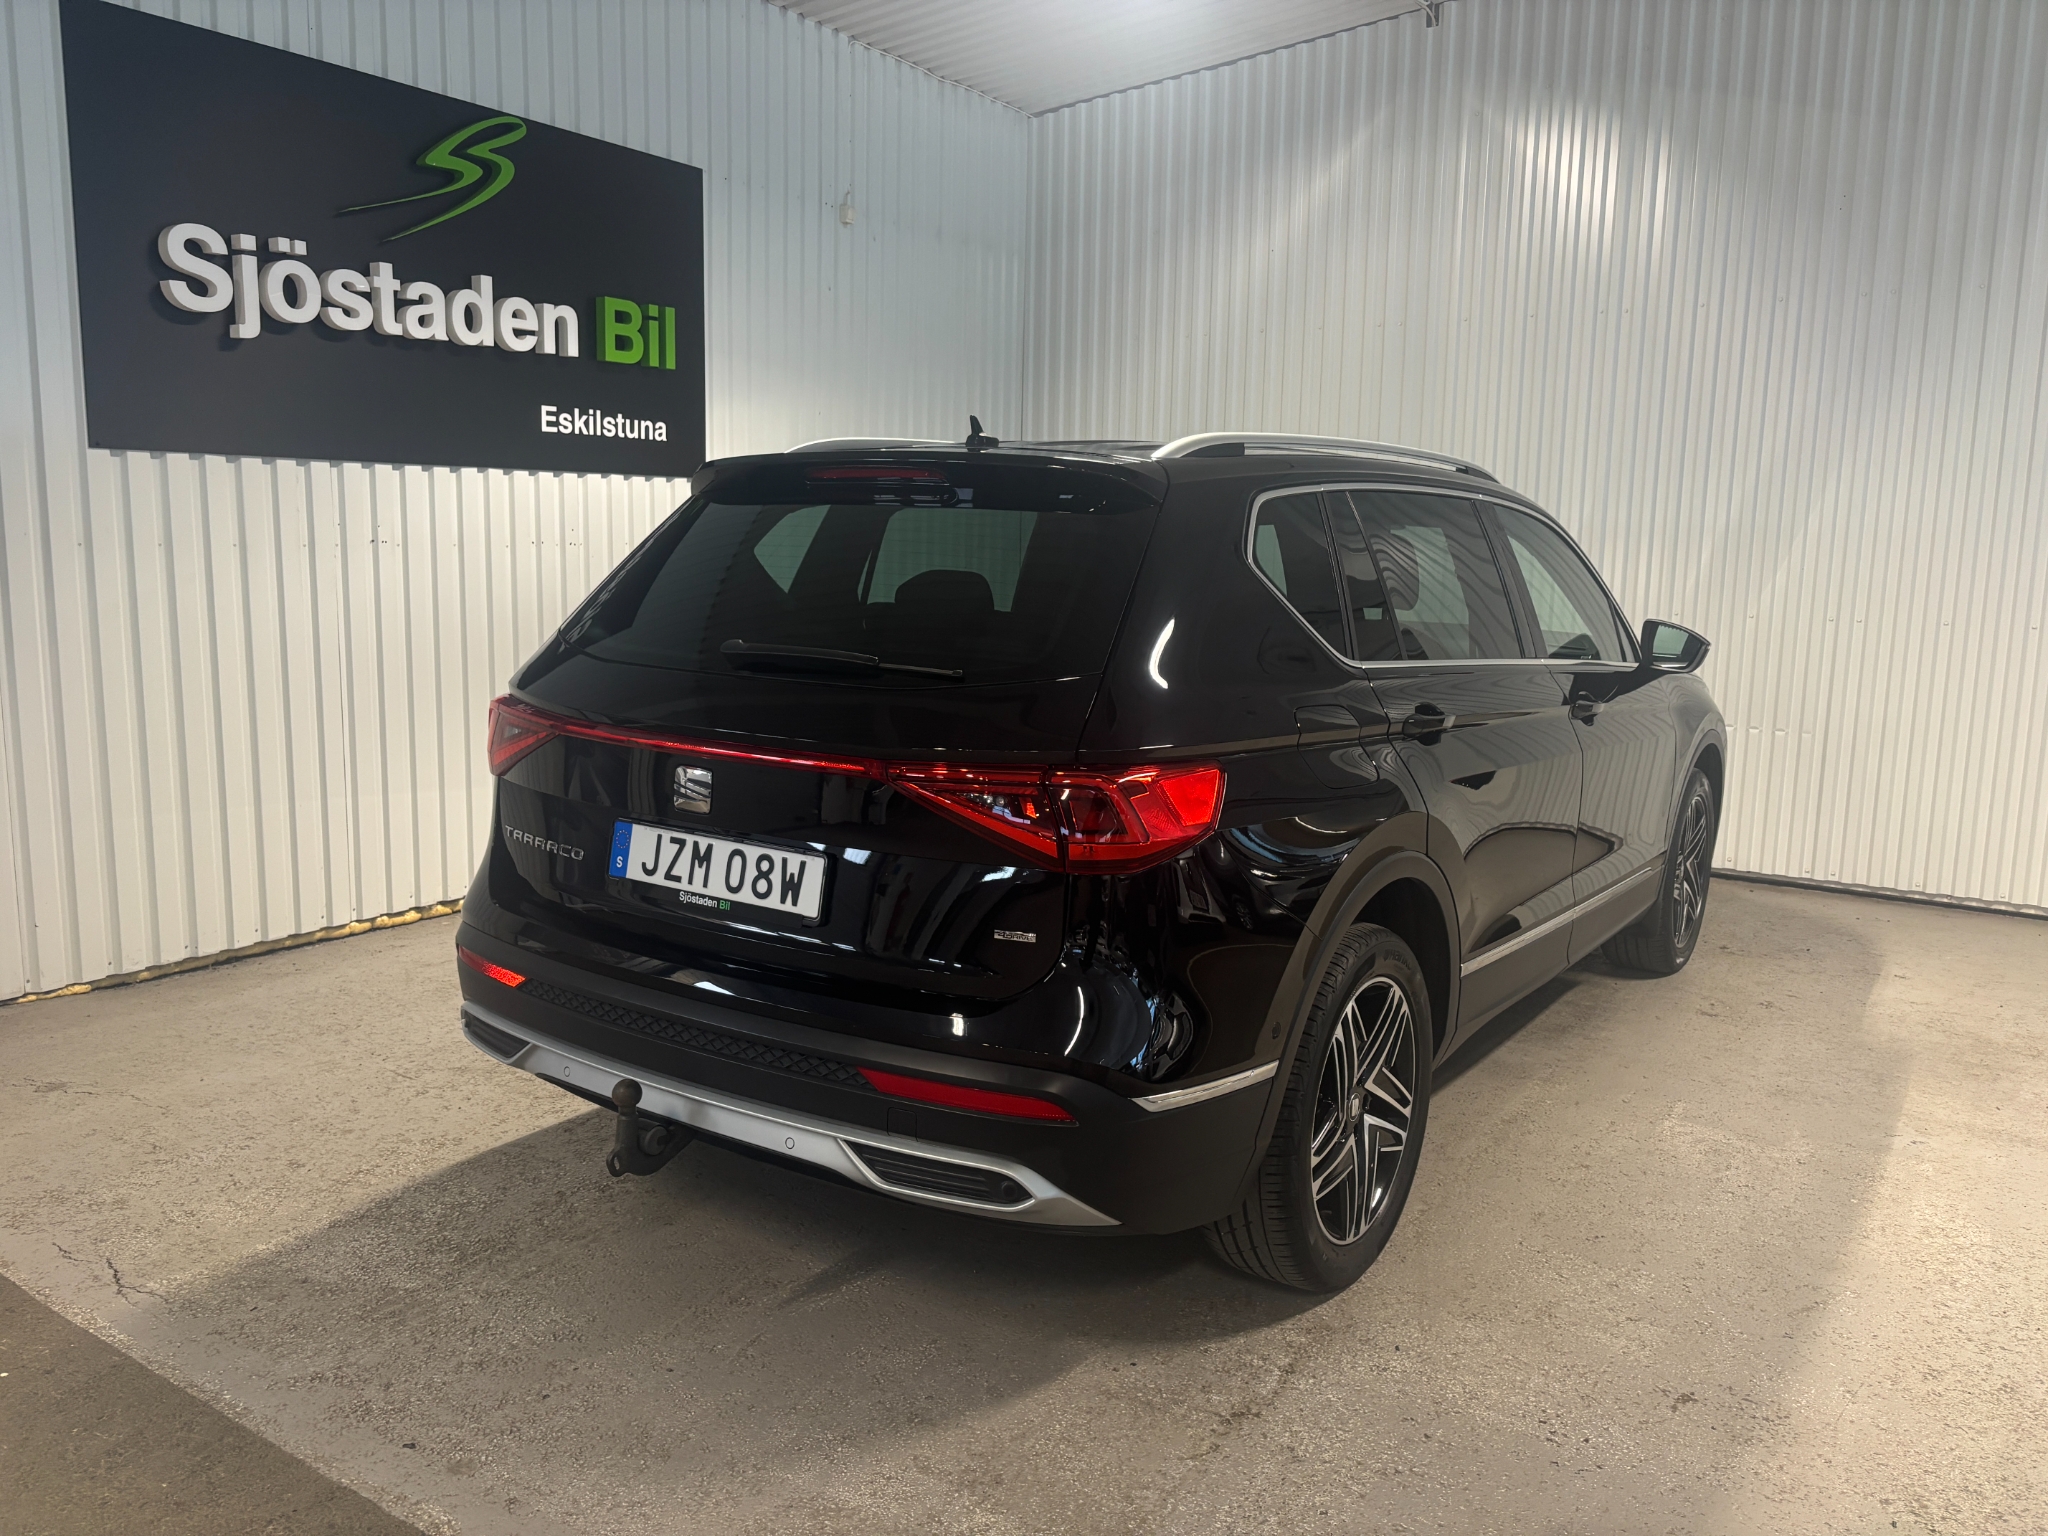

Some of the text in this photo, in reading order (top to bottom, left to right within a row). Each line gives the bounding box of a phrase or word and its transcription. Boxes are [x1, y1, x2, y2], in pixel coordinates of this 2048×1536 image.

[158, 222, 676, 371] Sjöstaden Bil
[541, 404, 668, 443] Eskilstuna
[504, 824, 585, 861] TARRACO
[616, 855, 624, 868] S
[641, 833, 807, 908] JZM 08W
[678, 891, 731, 911] Sjöstaden Bil
